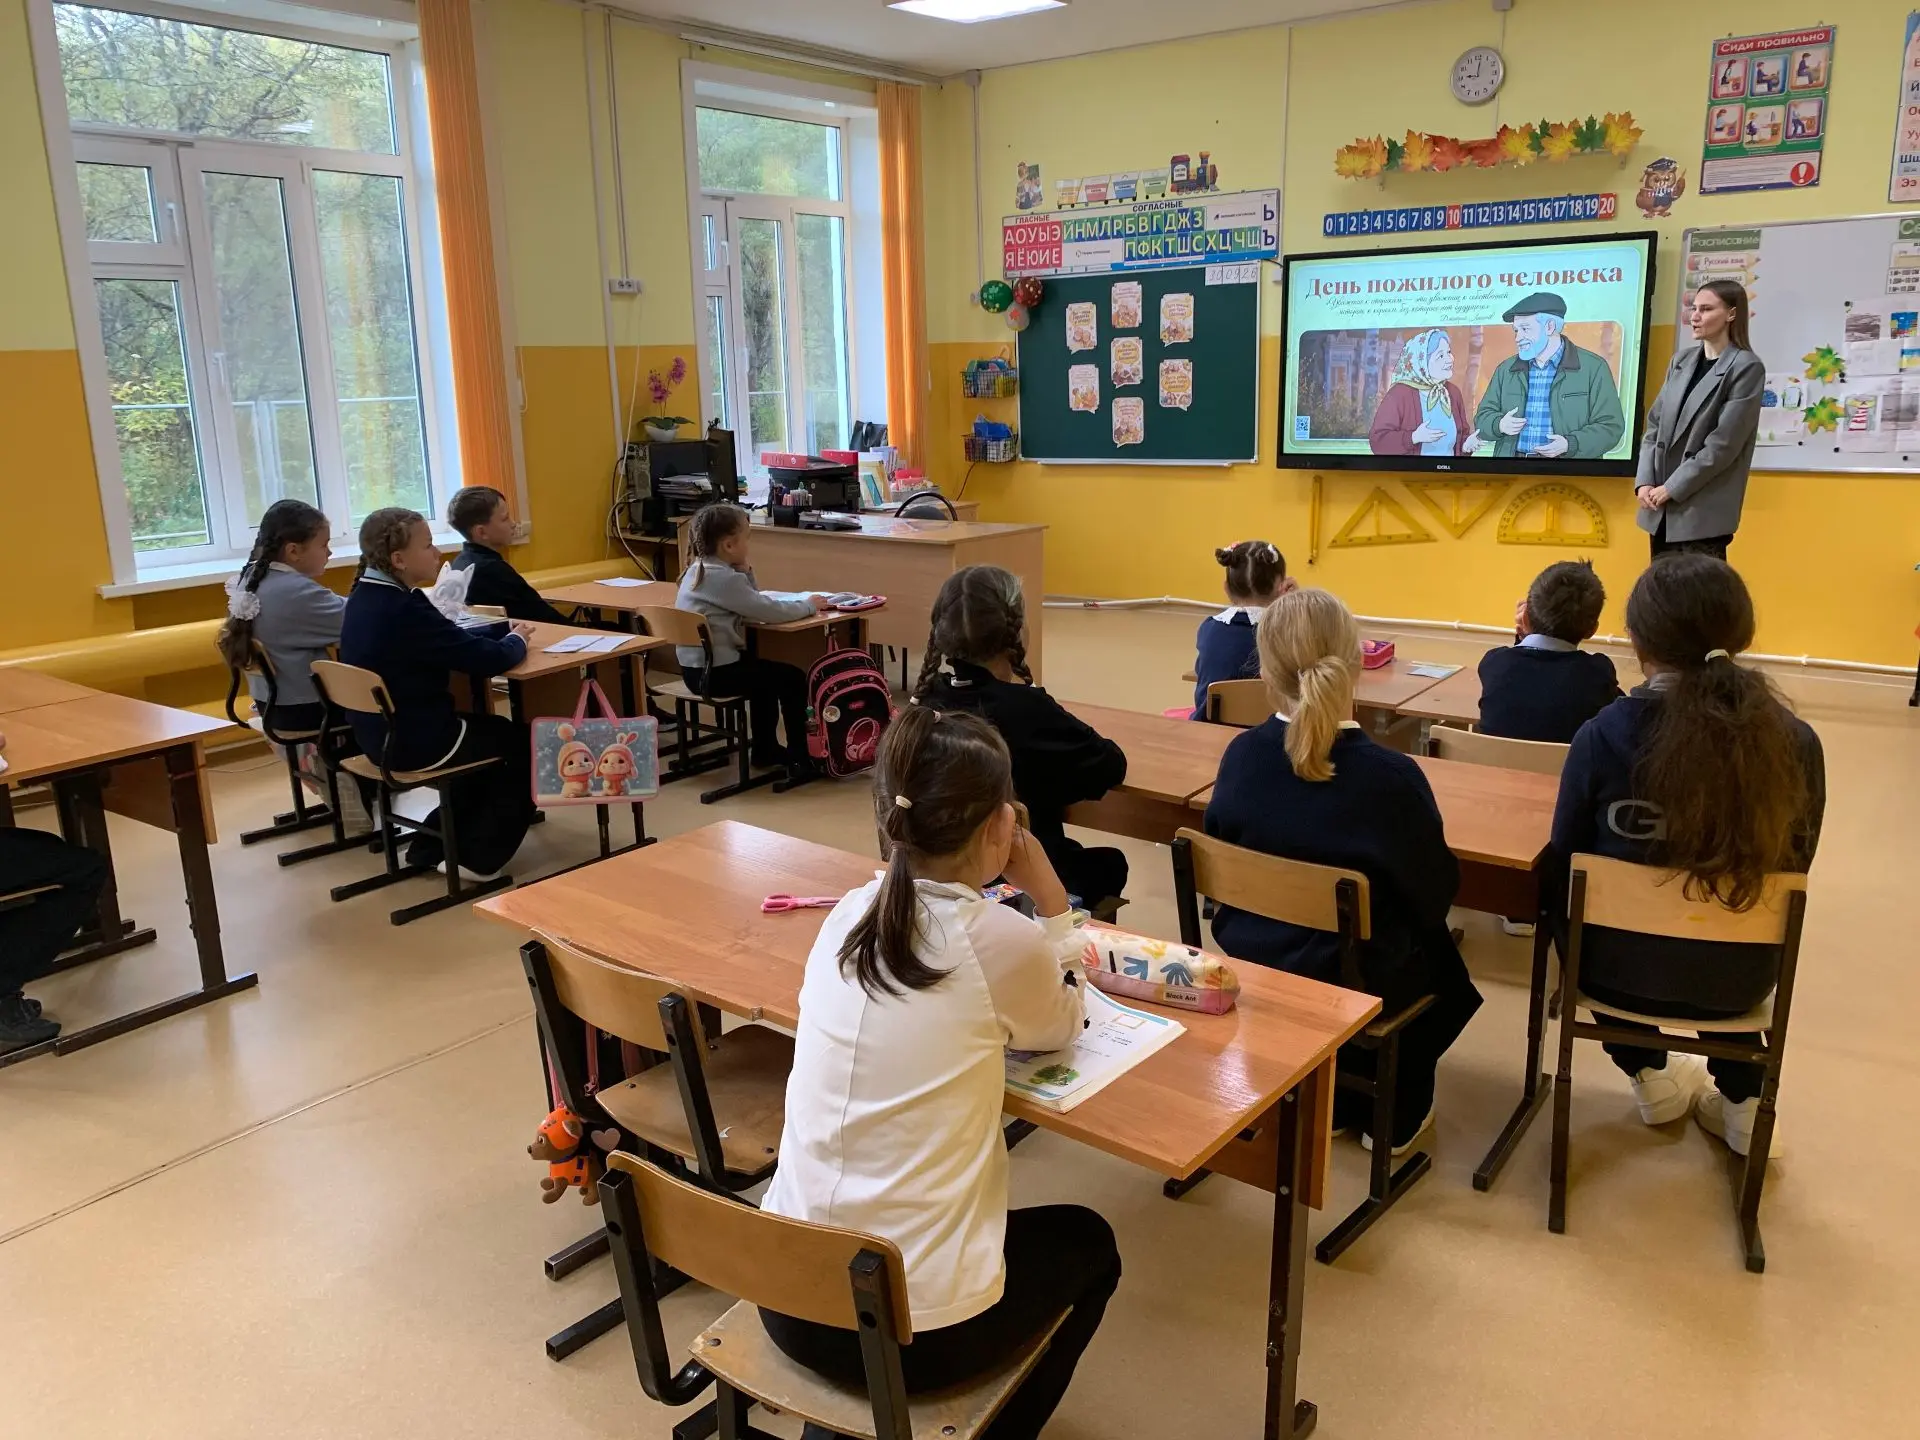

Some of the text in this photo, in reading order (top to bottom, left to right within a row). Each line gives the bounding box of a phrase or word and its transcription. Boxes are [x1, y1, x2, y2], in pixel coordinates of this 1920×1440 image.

[1720, 32, 1825, 53] Сиди правильно
[1132, 200, 1183, 213] СОГЛАСНЫЕ
[1326, 197, 1615, 232] 0 1 2 3 4 5 6 7 8 9 10 11 12 13 14 15 16 17 18 19 20
[1015, 214, 1051, 225] ГЛАСНЫЕ
[1306, 266, 1623, 299] День пожилого человека
[1607, 799, 1668, 840] G
[1166, 992, 1183, 1000] Black
